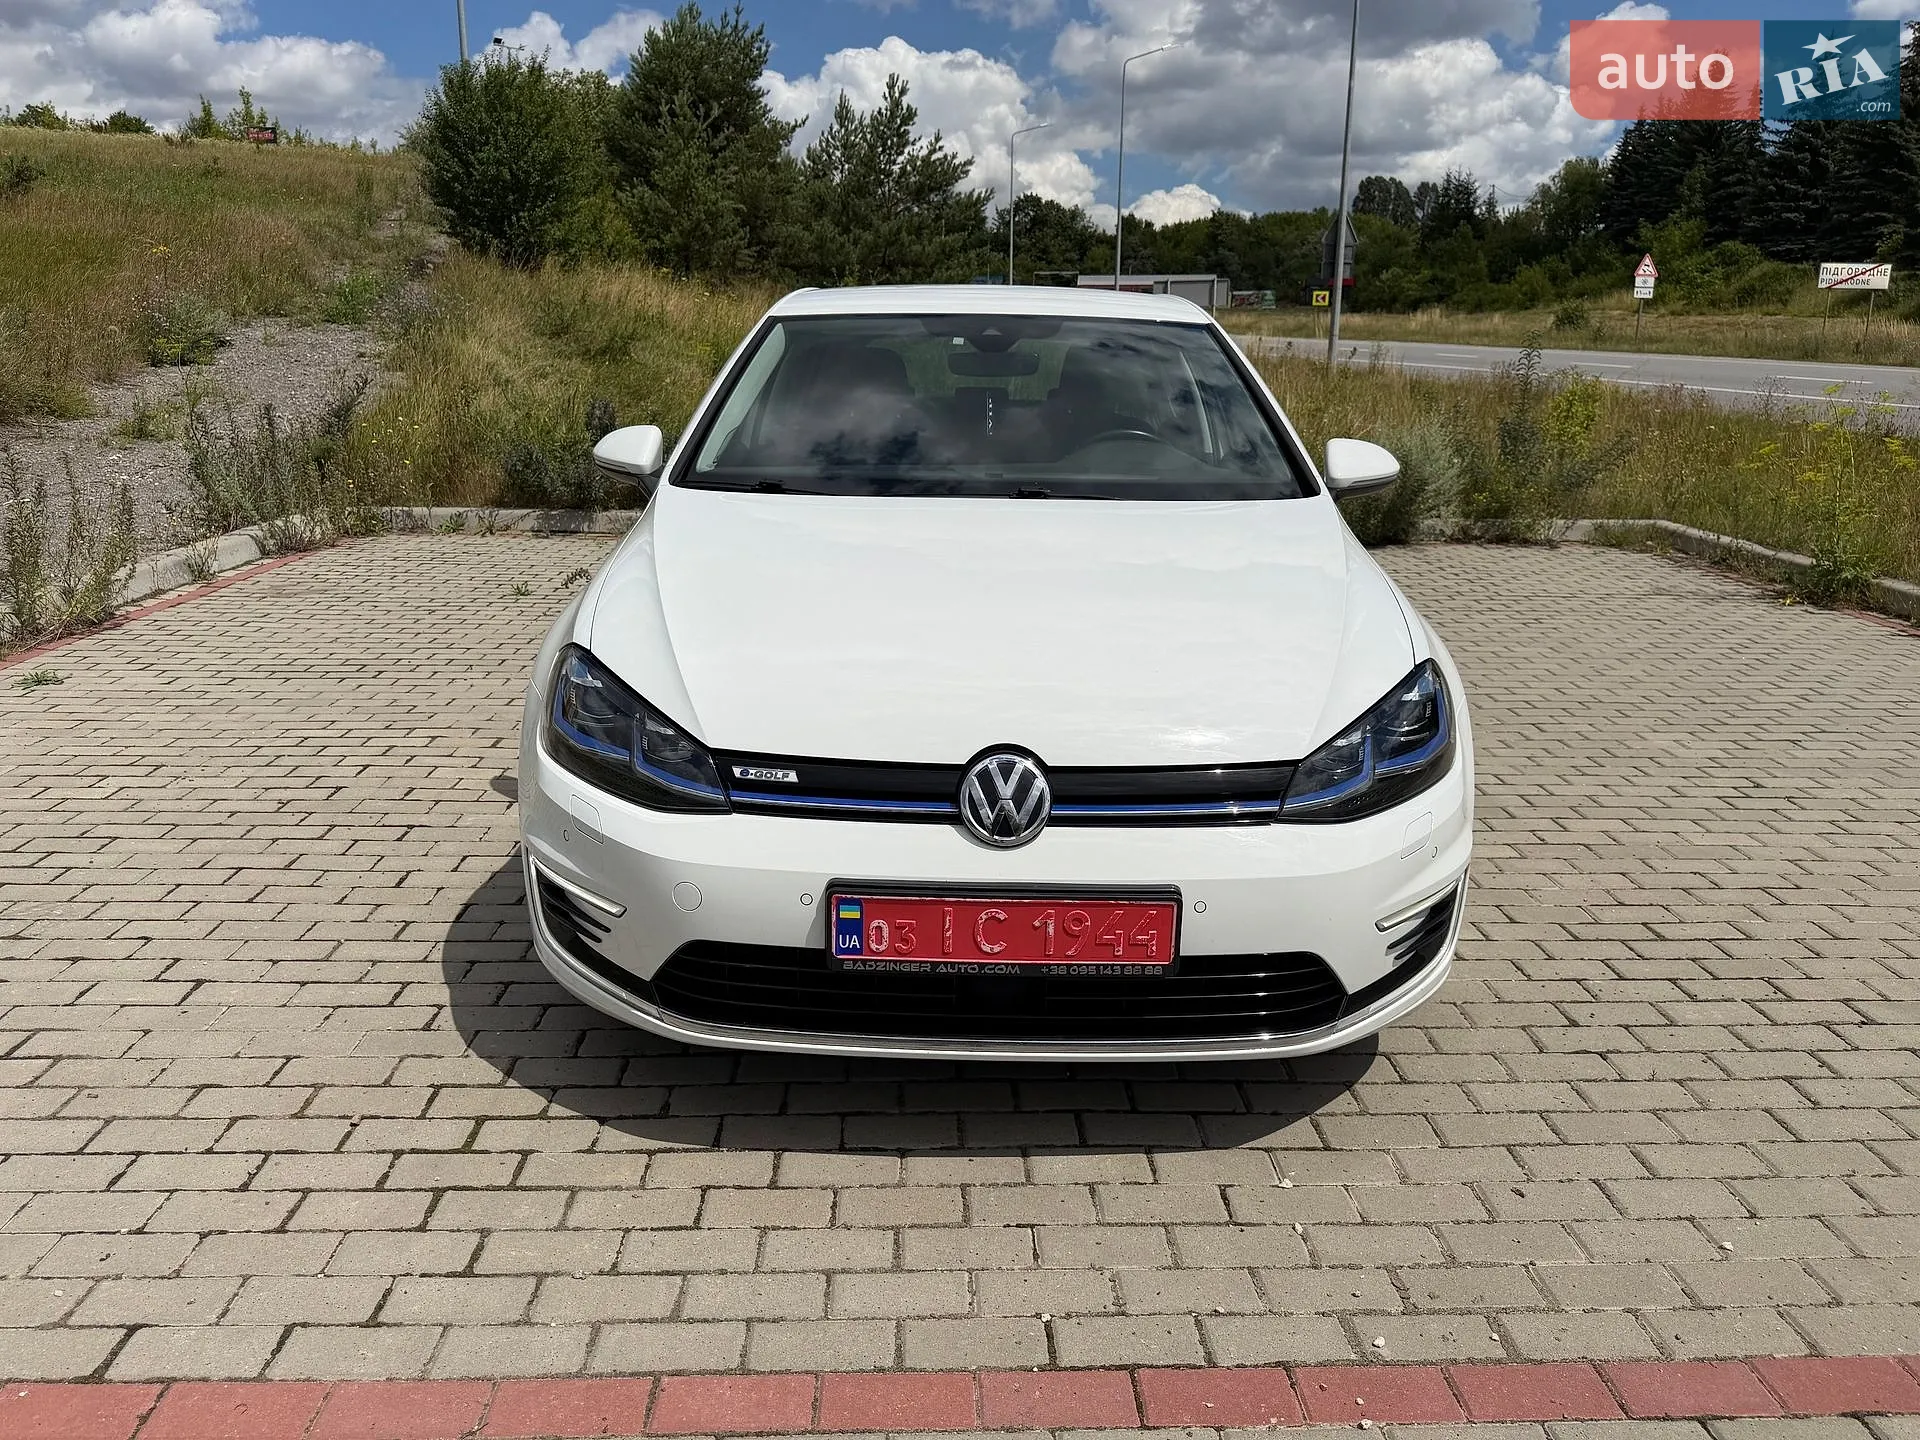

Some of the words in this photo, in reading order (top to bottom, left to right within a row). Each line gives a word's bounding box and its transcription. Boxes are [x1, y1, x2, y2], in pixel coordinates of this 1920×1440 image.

[1821, 267, 1889, 277] ПІДГОРОДНЕ
[868, 919, 917, 954] 03
[1033, 909, 1157, 956] 1944
[839, 934, 860, 949] UA
[842, 960, 932, 972] BADZINGER
